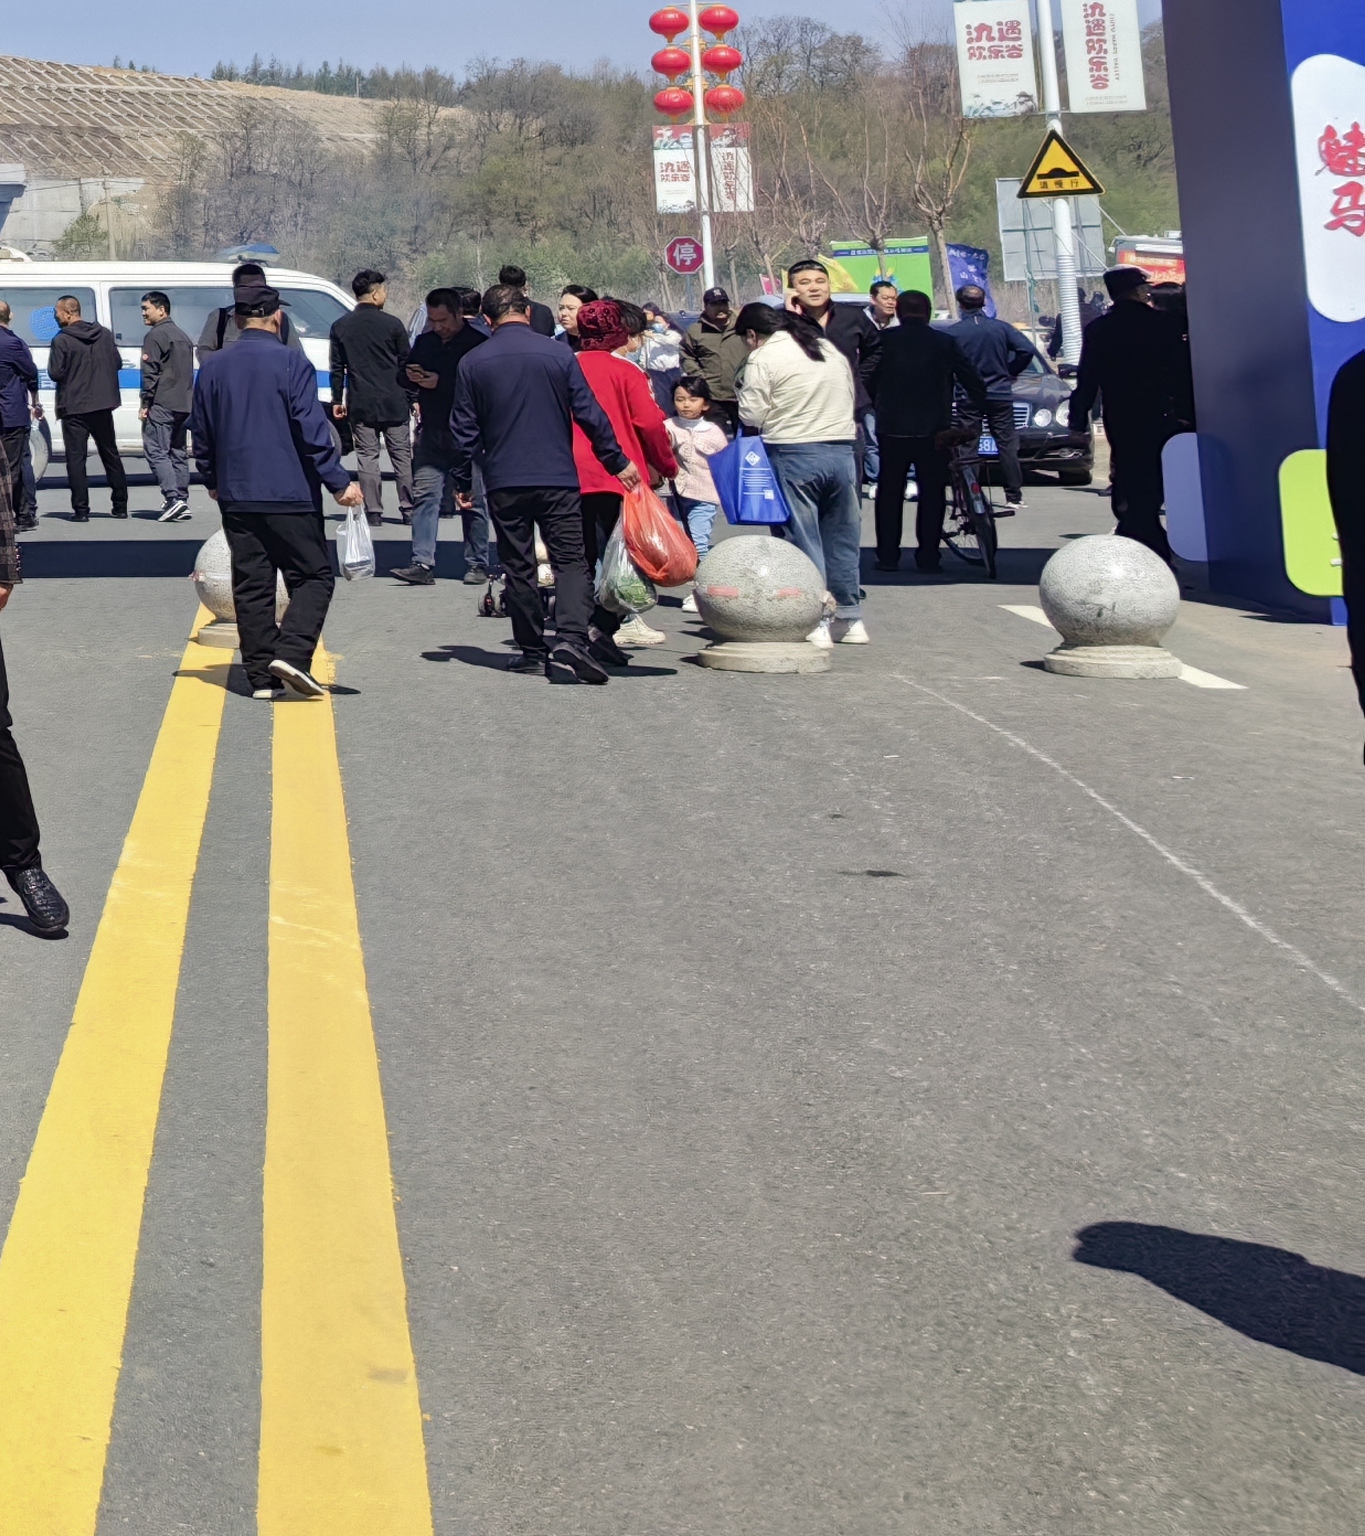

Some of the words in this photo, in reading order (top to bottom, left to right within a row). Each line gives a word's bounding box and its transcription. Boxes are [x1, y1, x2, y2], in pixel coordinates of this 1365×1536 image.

[967, 43, 1024, 61] 欢乐谷
[673, 242, 697, 267] 停
